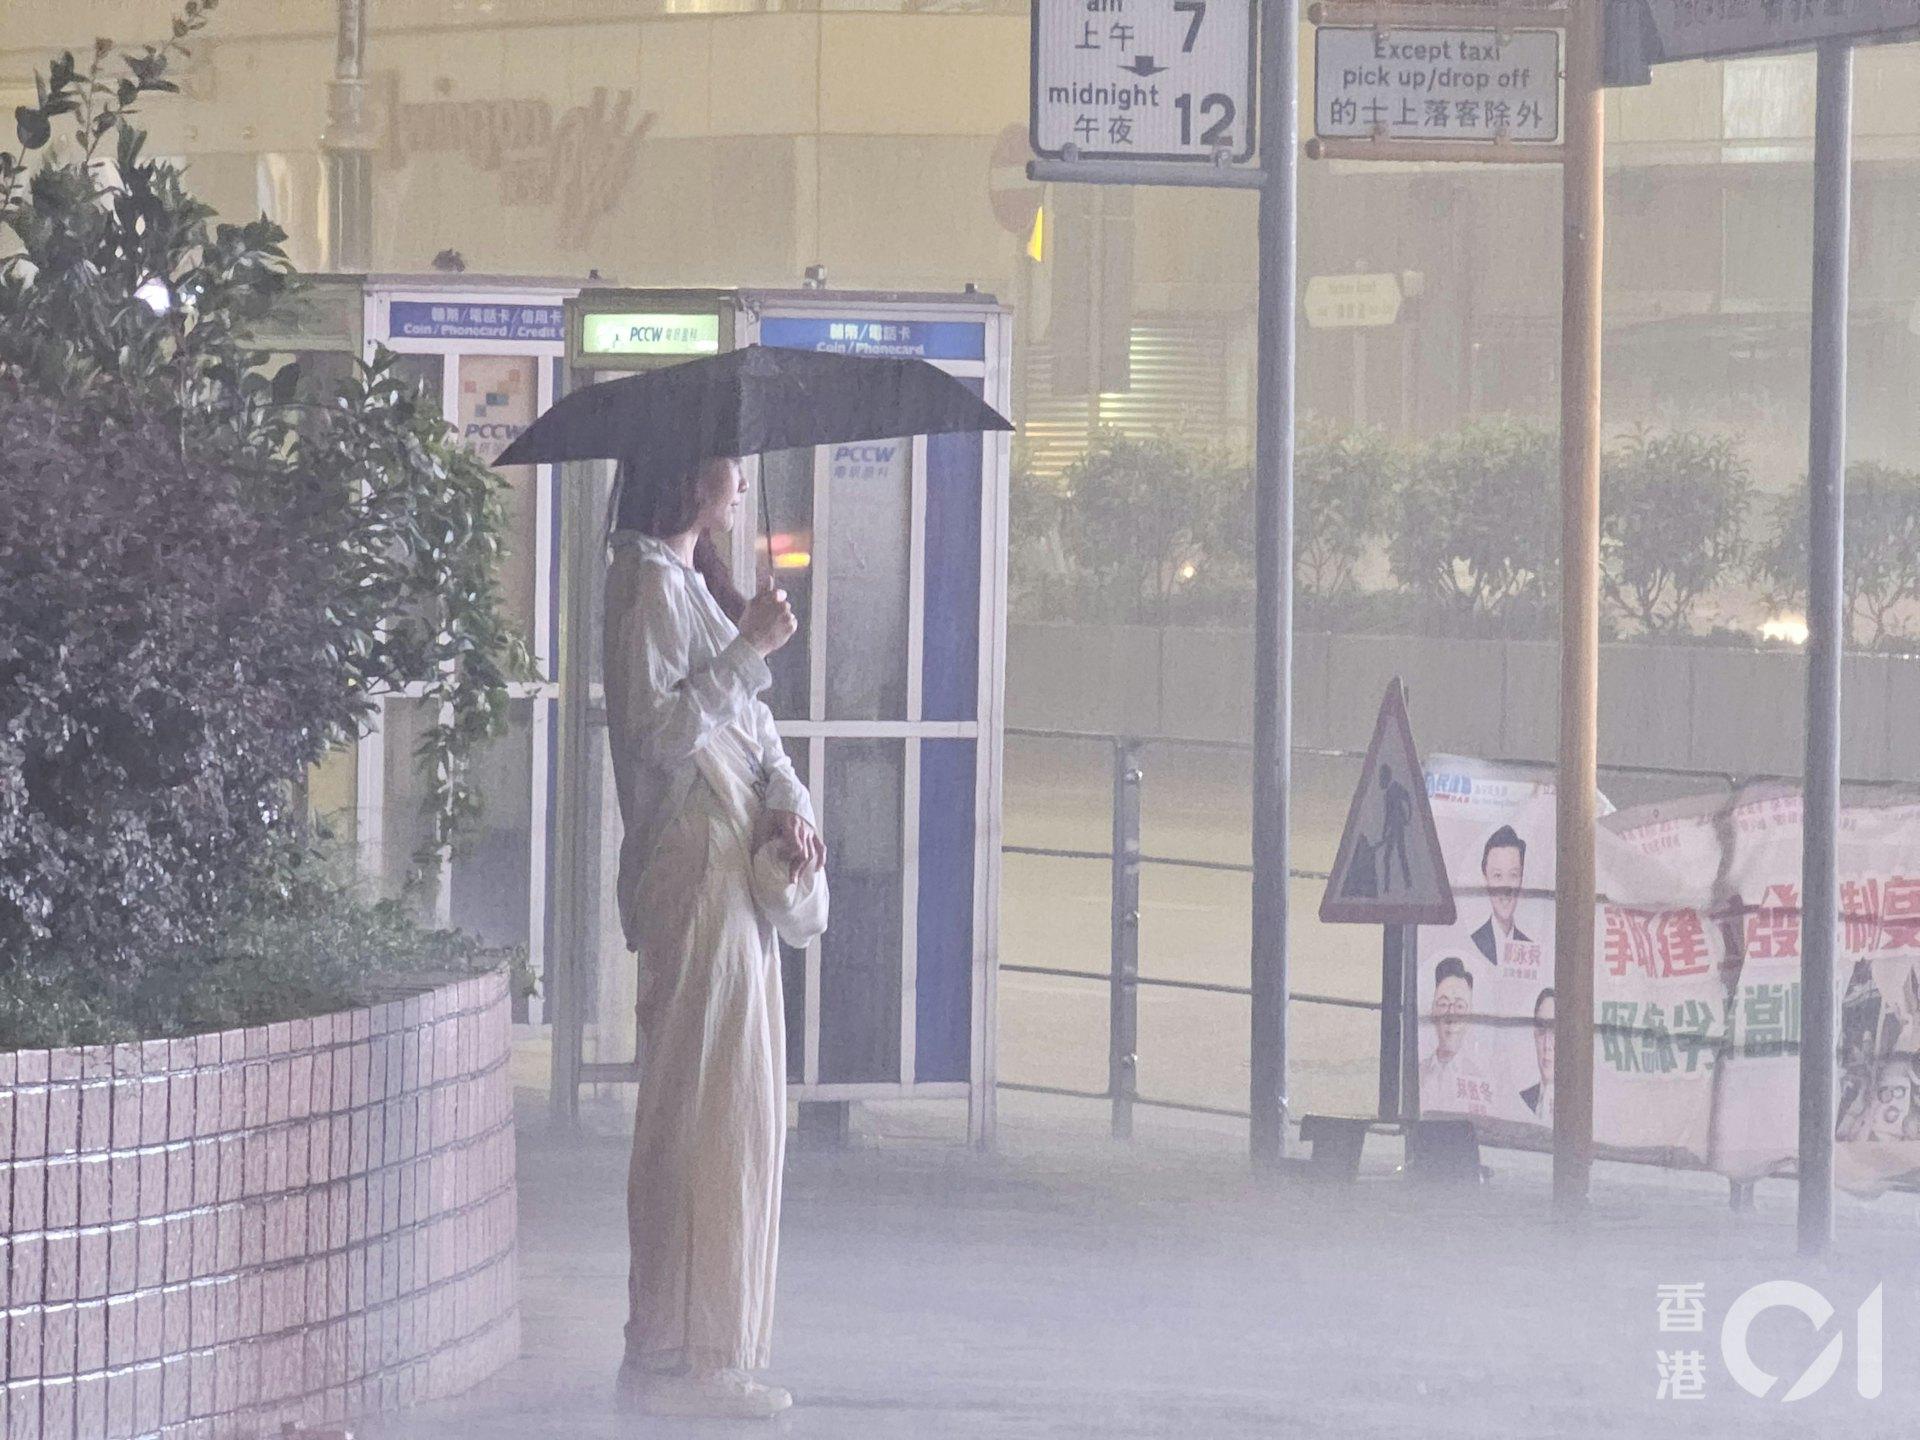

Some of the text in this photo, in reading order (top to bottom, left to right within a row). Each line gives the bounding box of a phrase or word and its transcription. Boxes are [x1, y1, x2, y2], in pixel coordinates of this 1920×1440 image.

[1074, 20, 1135, 51] 上午
[1173, 1, 1207, 53] 7
[1373, 40, 1500, 64] Except taxi
[1342, 66, 1530, 92] pick up/drop off
[1048, 82, 1160, 110] midnight
[1174, 92, 1236, 146] 12
[1329, 97, 1543, 129] 的士上落客除外
[1073, 114, 1134, 145] 午夜
[403, 322, 432, 335] Coin
[629, 326, 664, 342] PCCW
[465, 424, 528, 440] PCCW
[833, 446, 897, 463] PCCW
